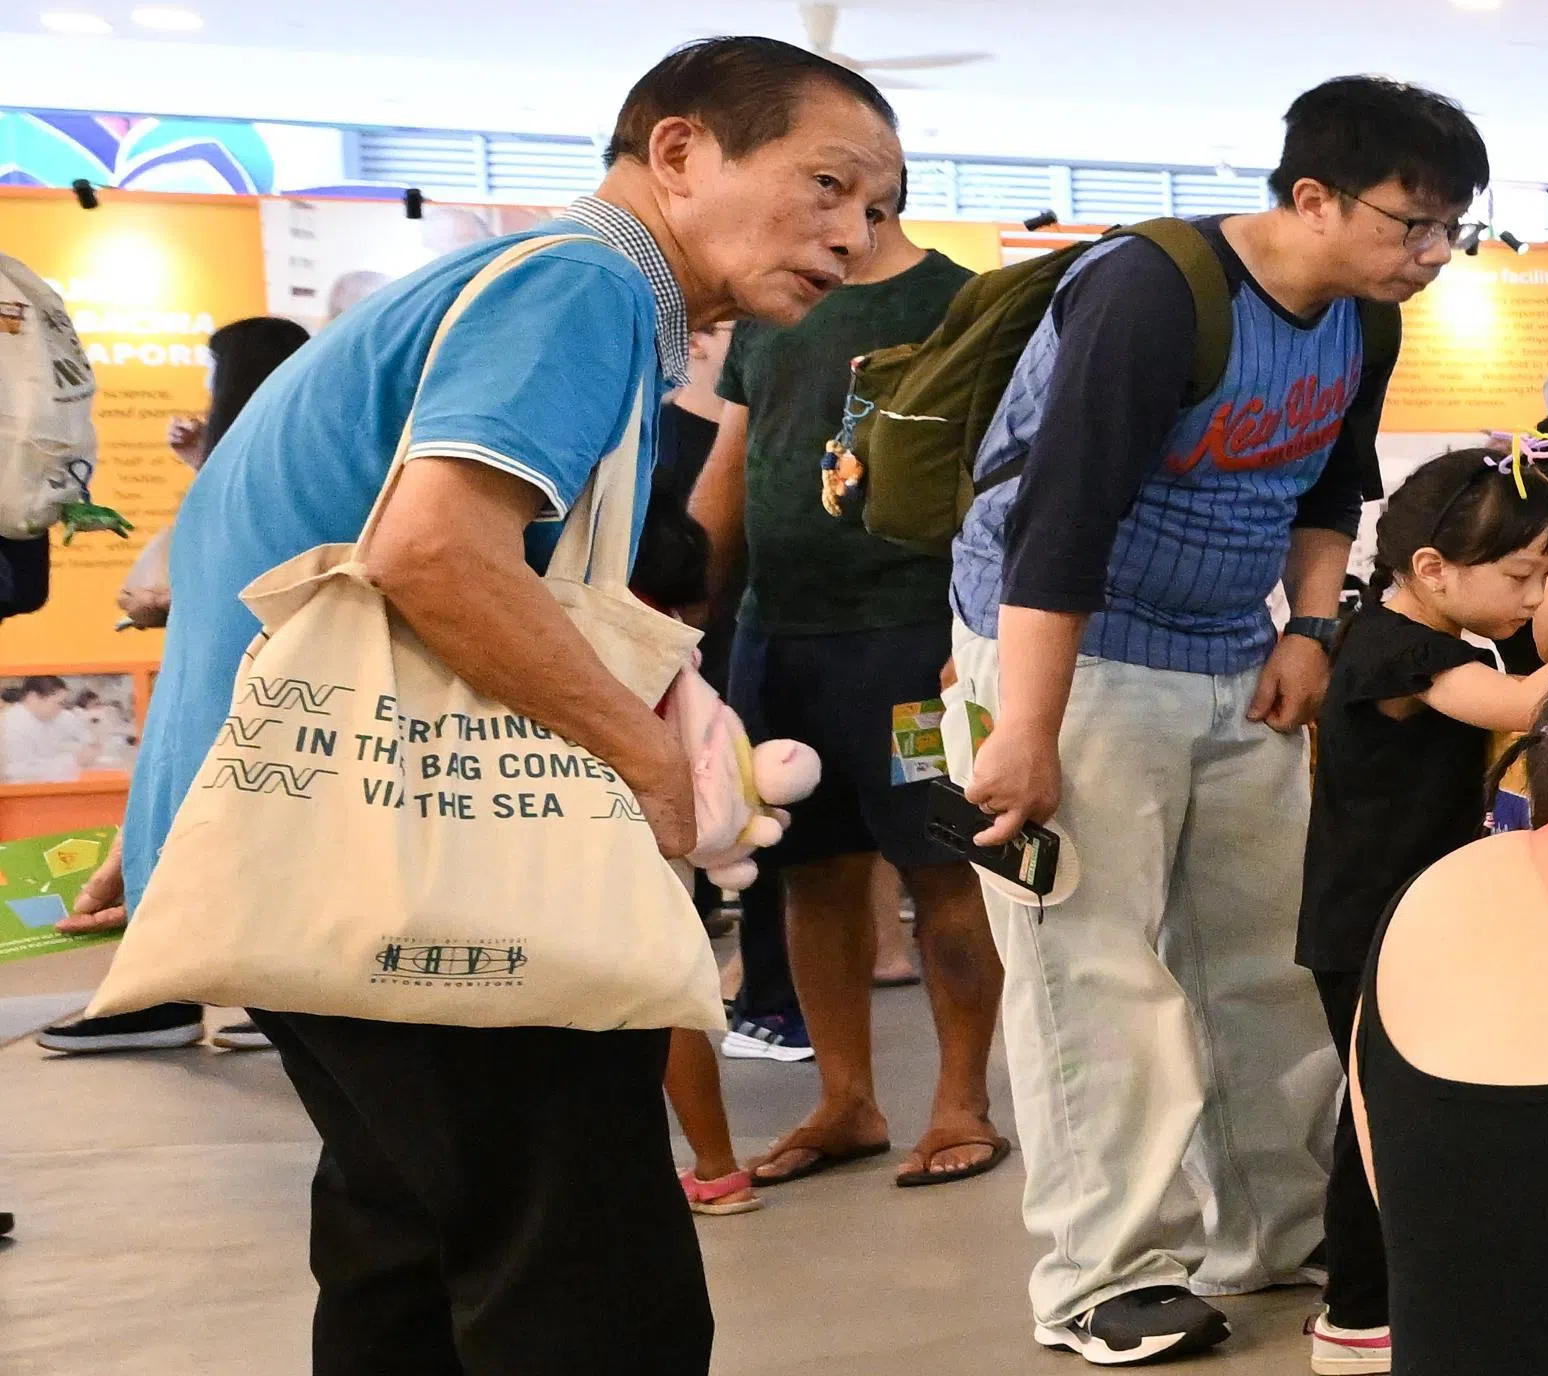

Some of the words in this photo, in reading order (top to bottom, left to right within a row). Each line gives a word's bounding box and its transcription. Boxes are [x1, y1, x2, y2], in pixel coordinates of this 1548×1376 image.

[296, 726, 336, 756] IN
[422, 753, 482, 779] BAG
[499, 753, 616, 783] COMES
[414, 793, 476, 818] THE
[492, 793, 564, 817] SEA
